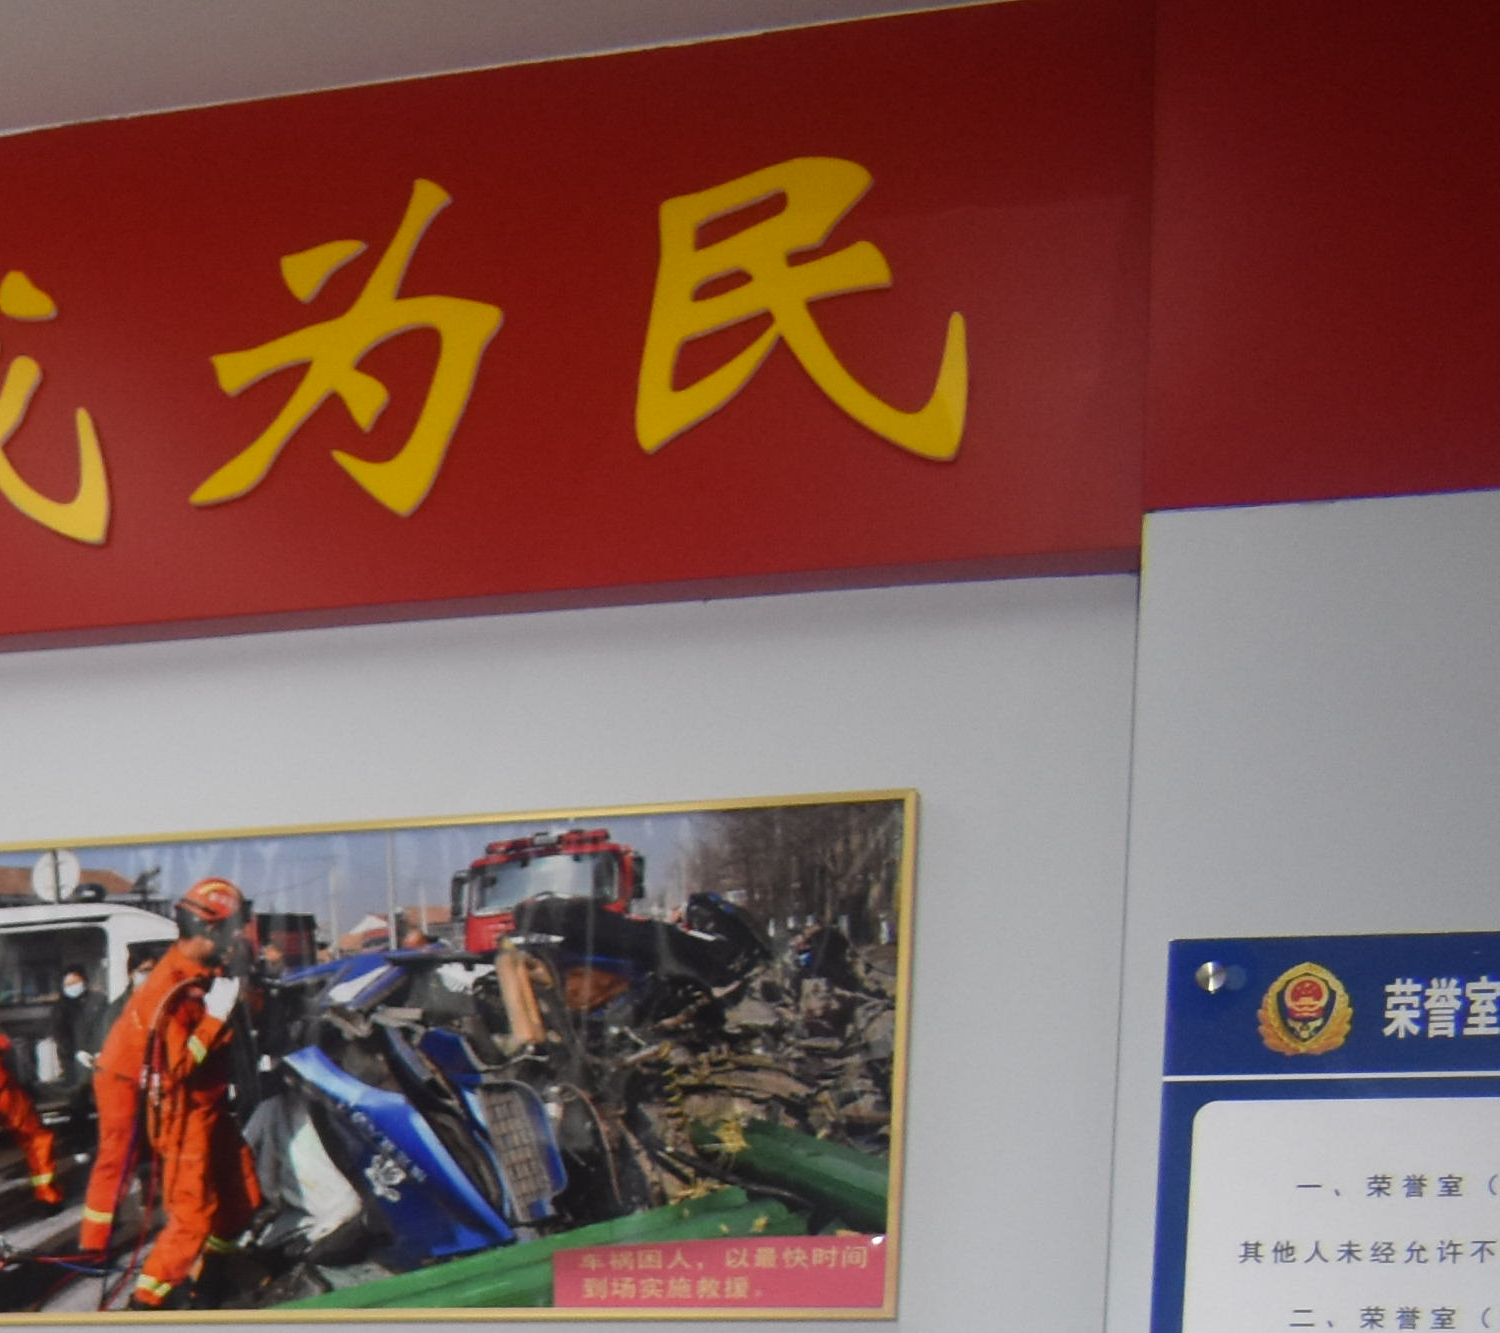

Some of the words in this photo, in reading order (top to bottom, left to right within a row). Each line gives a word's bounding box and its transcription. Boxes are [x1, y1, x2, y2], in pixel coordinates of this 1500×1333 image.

[1383, 975, 1500, 1039] 荣誉室
[1238, 1240, 1498, 1266] 其他人未经允许不
